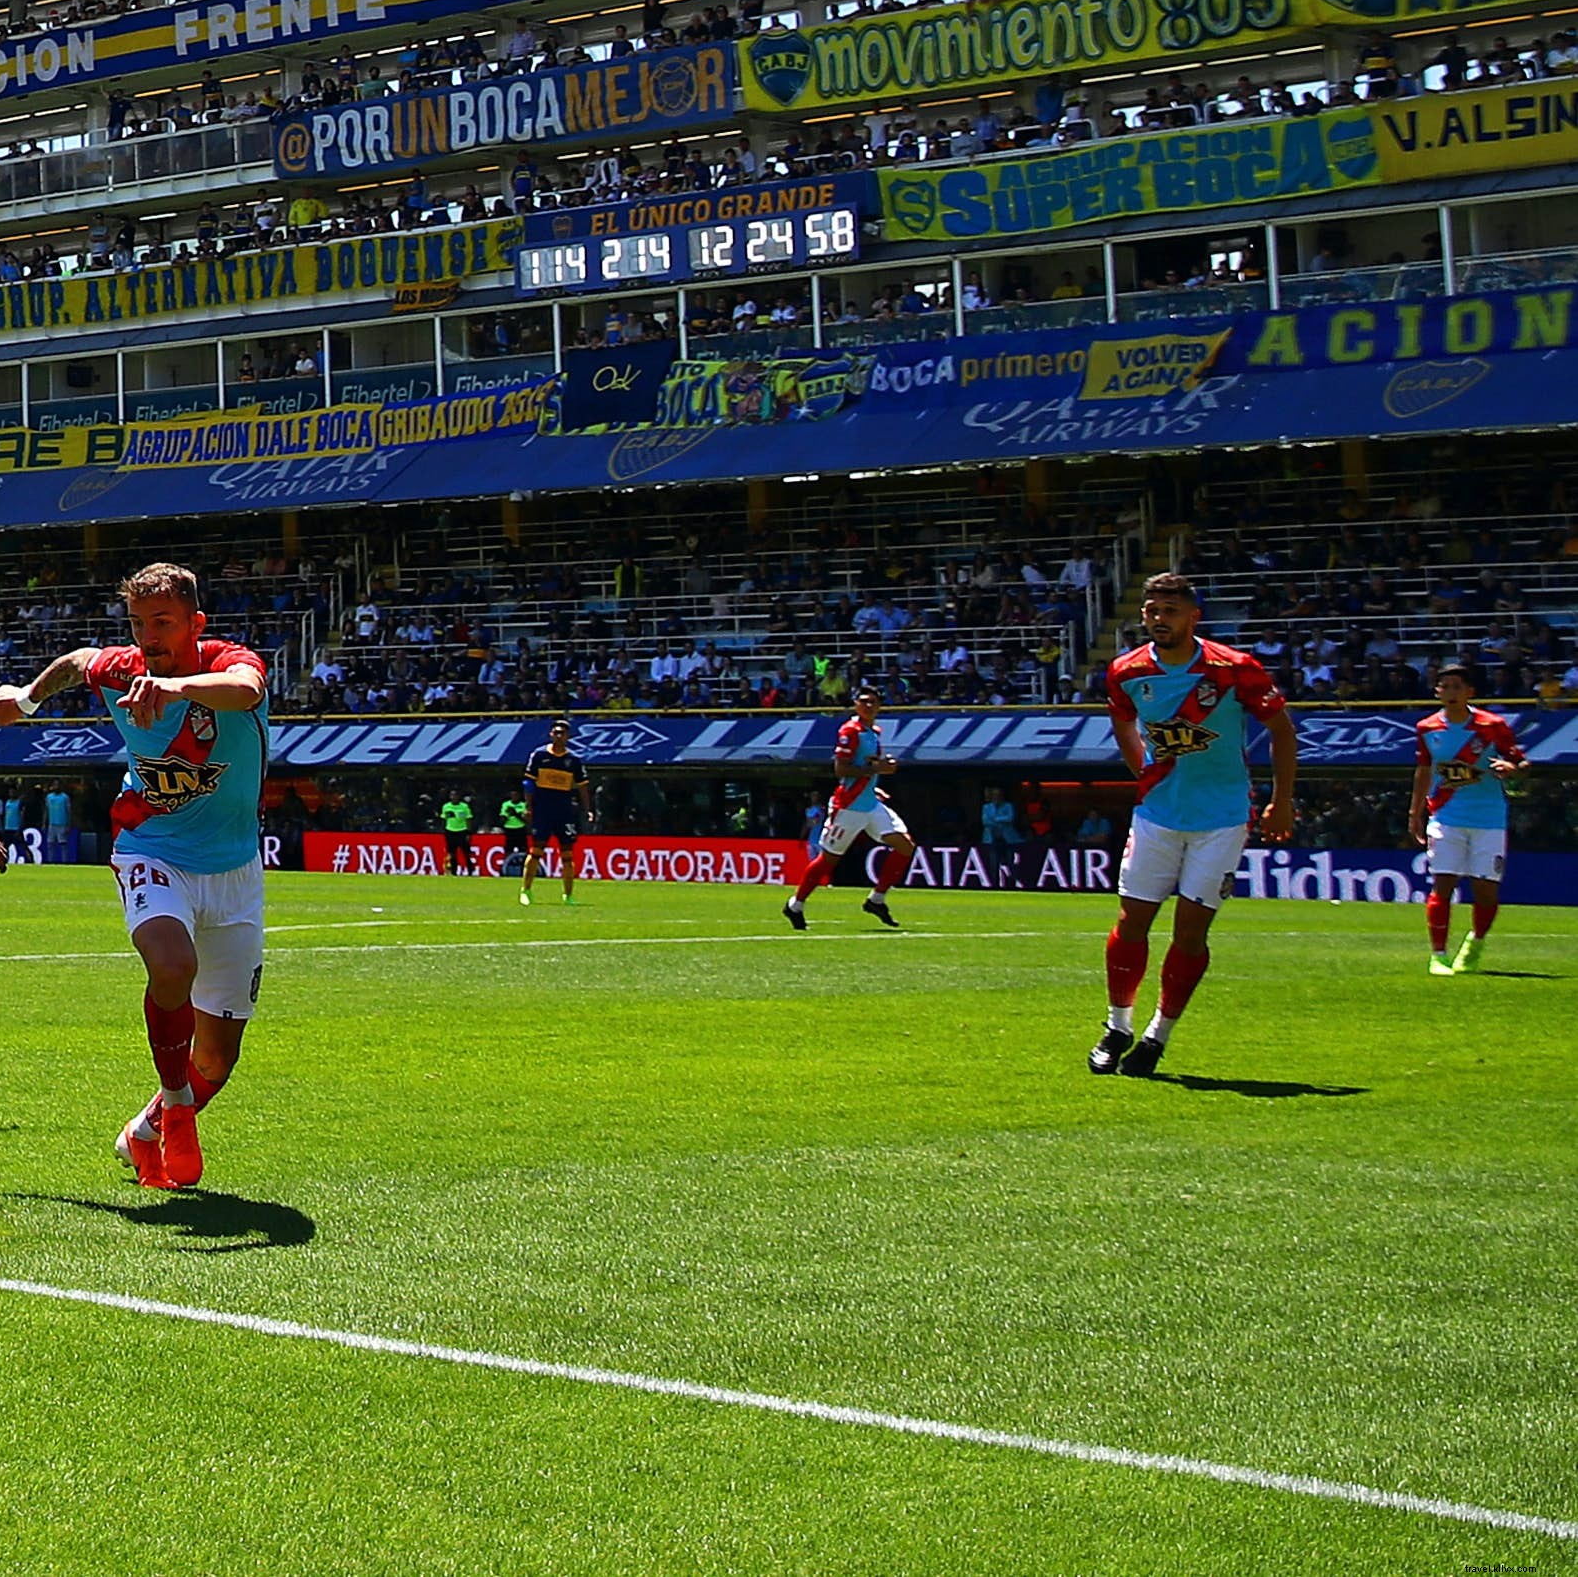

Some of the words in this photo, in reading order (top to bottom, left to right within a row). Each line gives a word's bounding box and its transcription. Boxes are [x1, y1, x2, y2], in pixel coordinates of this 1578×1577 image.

[940, 165, 1144, 236] SUPER
[1153, 121, 1333, 208] BOCA
[590, 213, 617, 235] EL
[629, 198, 712, 231] ÚNICO
[717, 183, 835, 219] GRANDE
[700, 226, 734, 267] 12
[746, 219, 794, 259] 24
[805, 210, 855, 254] 58
[85, 251, 297, 321] ALTERNATIVA
[315, 231, 487, 292] BOQUENSE
[870, 353, 956, 394] BOCA
[1116, 342, 1208, 370] VOLVER
[342, 379, 414, 405] Fibertel
[1103, 376, 1123, 393] A
[122, 421, 246, 463] AGRUPACION
[255, 417, 311, 456] DALE
[315, 407, 374, 451] BOCA
[997, 411, 1212, 446] AIRWAYS
[226, 472, 378, 501] AIRWAYS
[672, 720, 817, 762] LA
[158, 766, 201, 796] LN
[356, 844, 439, 875] NADA
[580, 849, 603, 881] A
[607, 848, 785, 884] GATORADE
